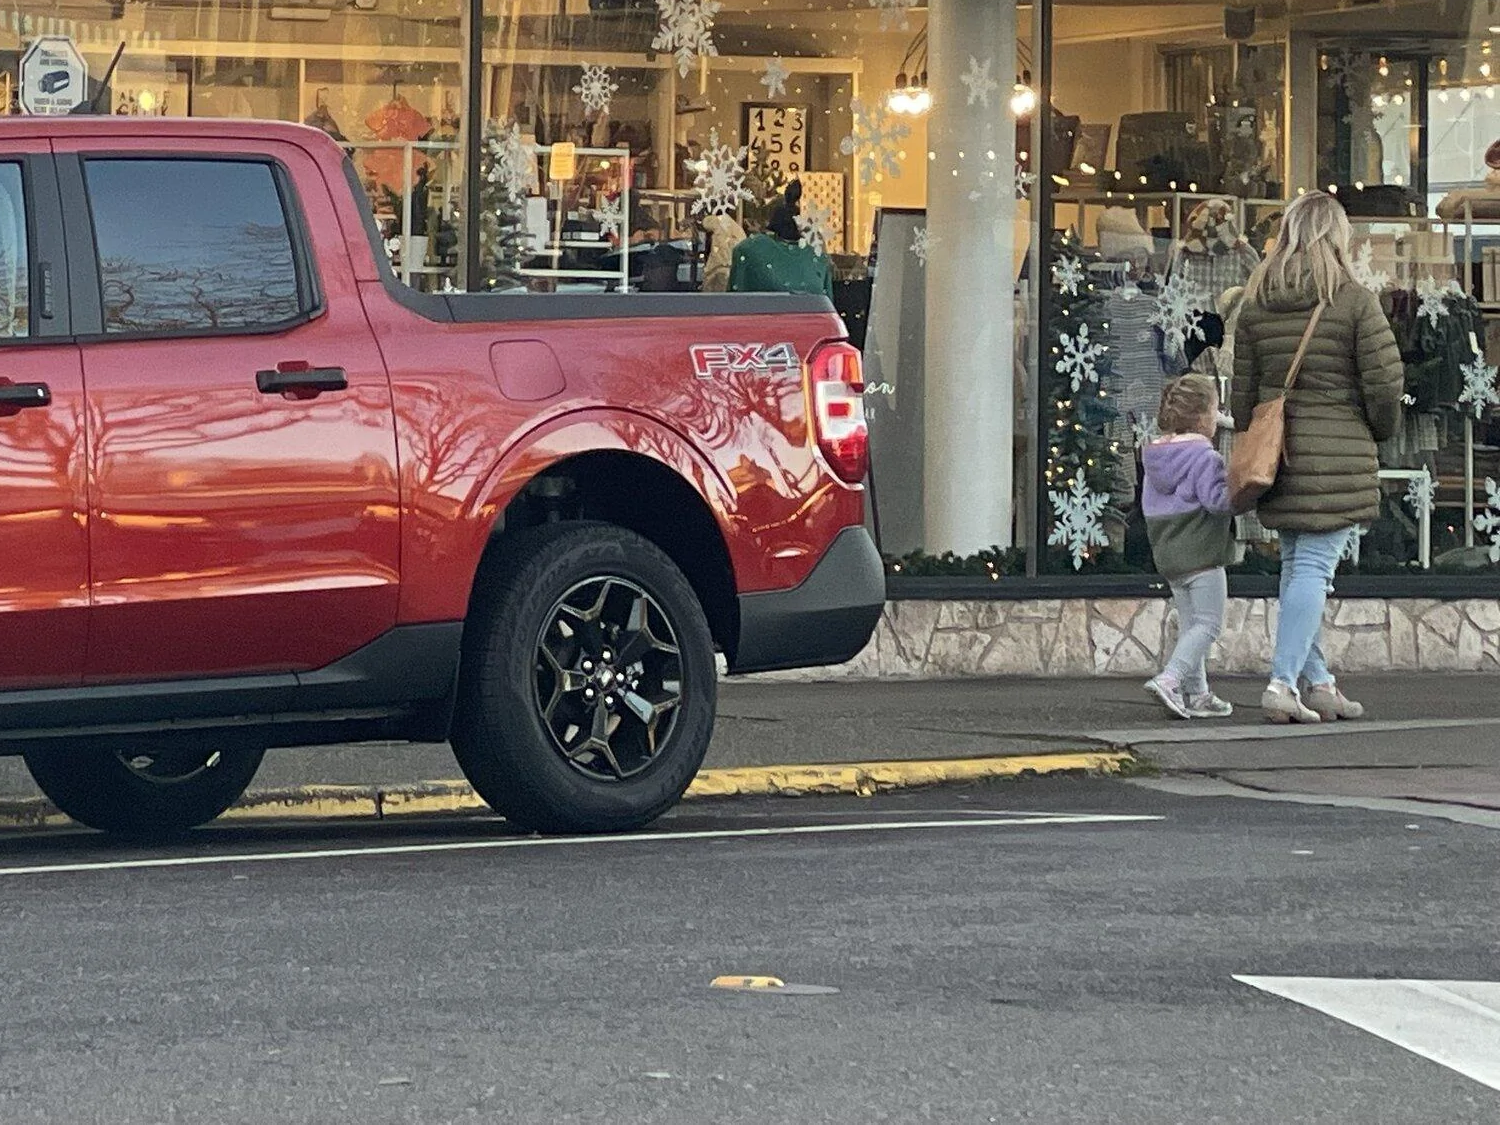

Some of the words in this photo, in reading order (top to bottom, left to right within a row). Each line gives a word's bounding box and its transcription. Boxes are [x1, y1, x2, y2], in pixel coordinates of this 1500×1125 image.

[754, 110, 766, 131] 1
[773, 107, 786, 128] 2
[791, 112, 803, 131] 3
[769, 133, 783, 153] 5
[789, 135, 802, 155] 6
[690, 342, 800, 379] FX4
